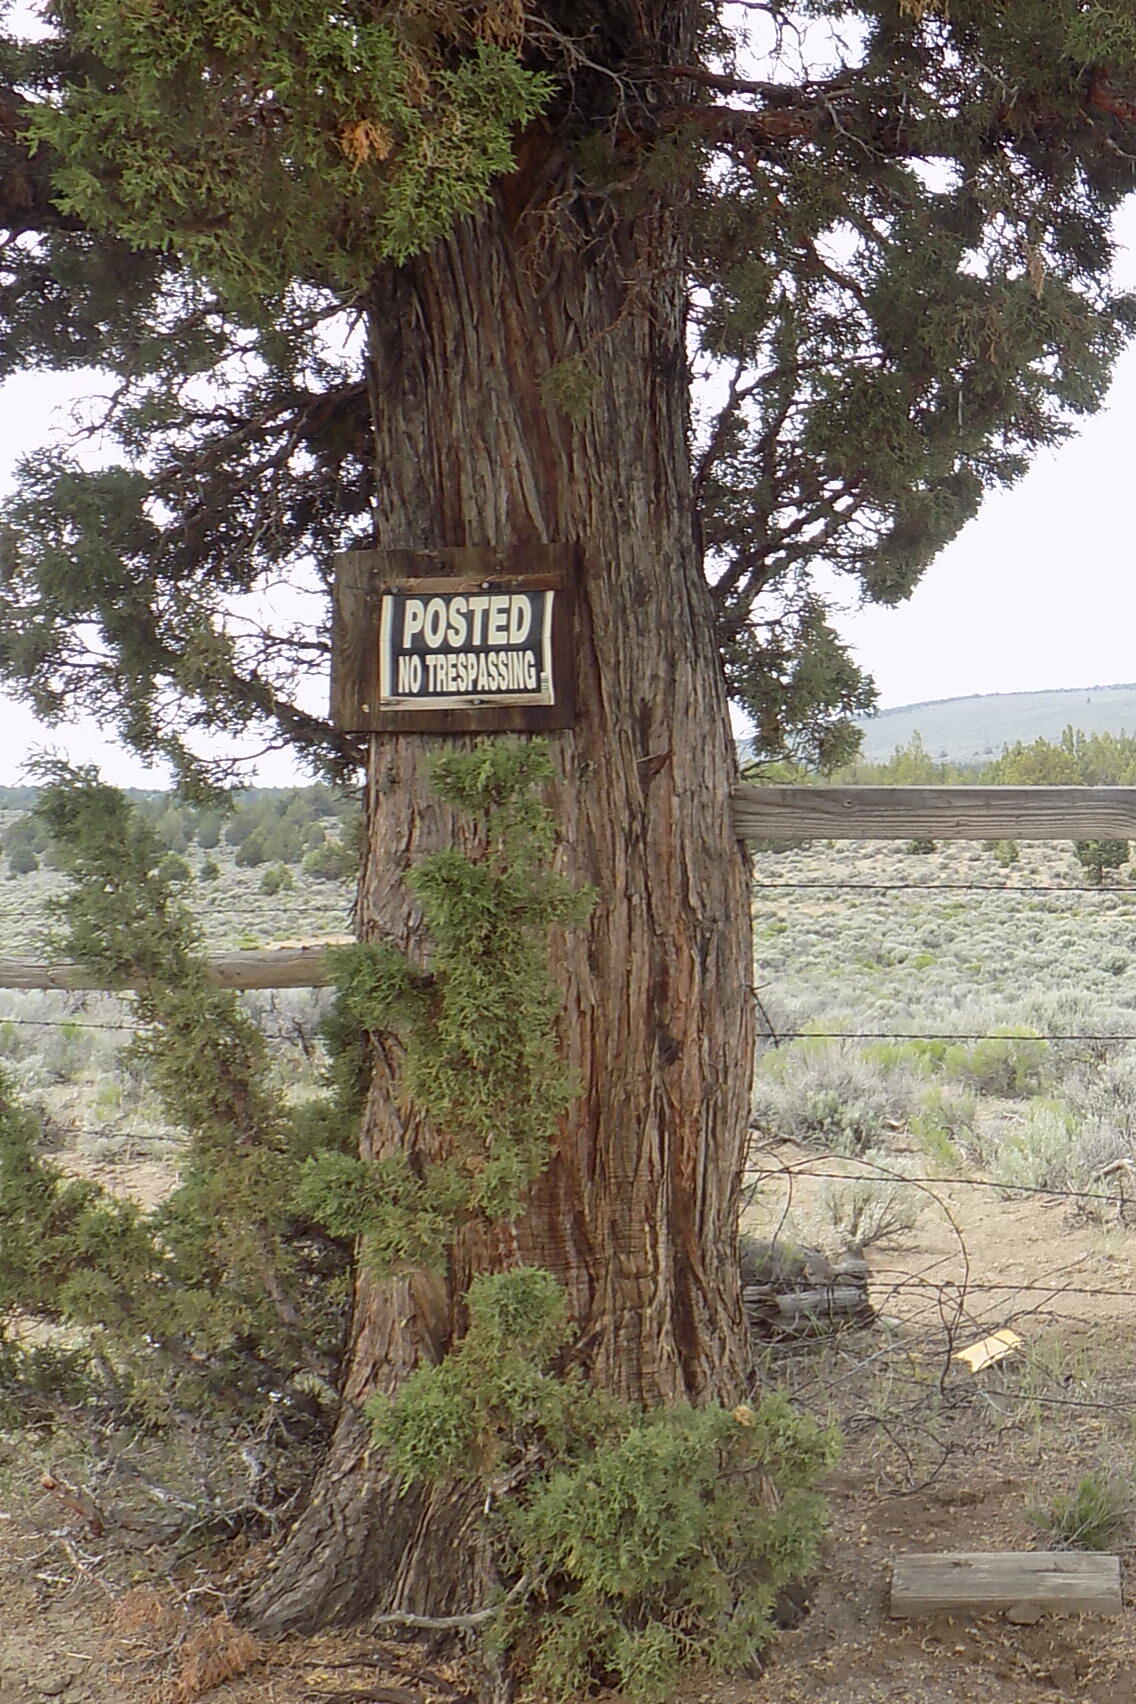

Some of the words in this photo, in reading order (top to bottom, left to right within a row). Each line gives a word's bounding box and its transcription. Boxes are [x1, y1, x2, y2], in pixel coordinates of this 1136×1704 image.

[403, 594, 531, 649] POSTED
[398, 654, 422, 693] NO
[425, 650, 537, 692] TRESPASSING
